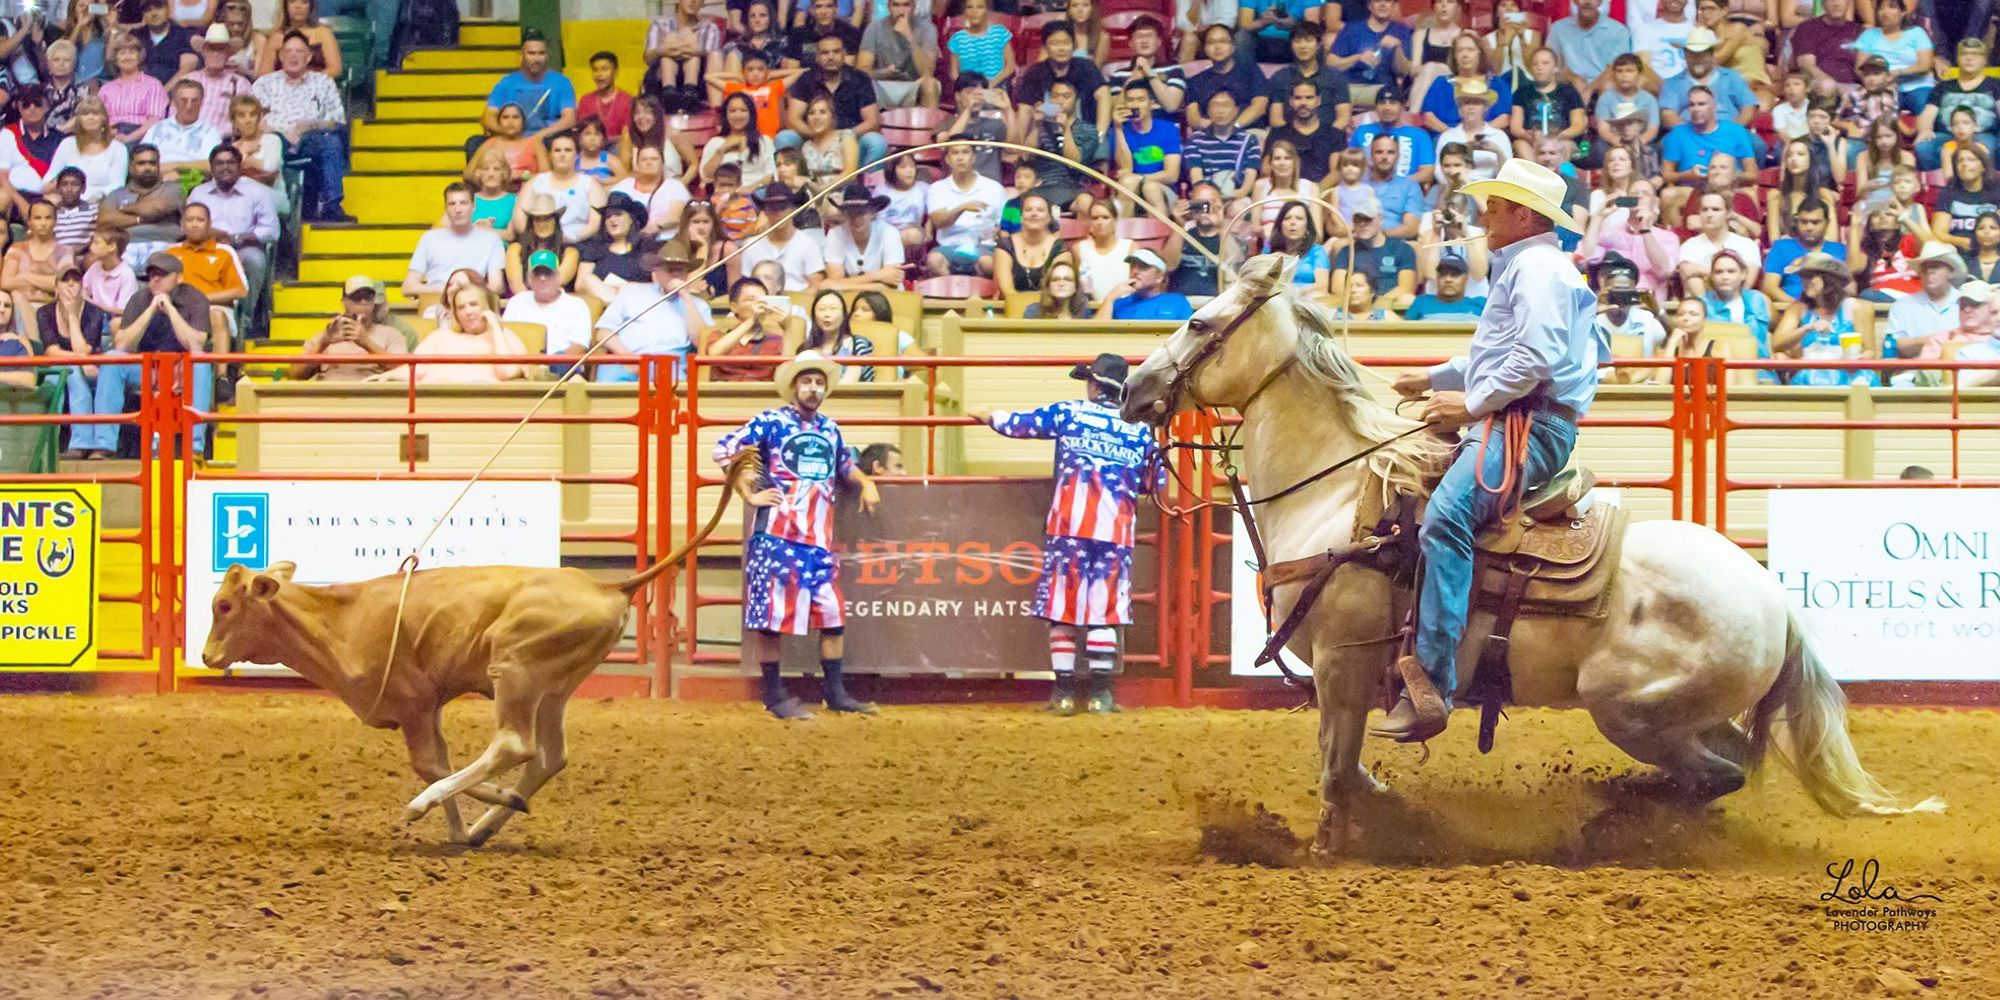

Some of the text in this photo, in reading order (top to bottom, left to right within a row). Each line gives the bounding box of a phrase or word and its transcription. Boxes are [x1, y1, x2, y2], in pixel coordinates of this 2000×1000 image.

[1060, 436, 1143, 465] STOCKYARDS
[1, 500, 76, 528] NTS
[287, 516, 529, 526] EMBASSY SUITES
[354, 547, 456, 557] HOTELS
[833, 541, 1043, 585] ETSO
[0, 582, 39, 596] OLD
[1777, 572, 1927, 609] HOTELS
[1936, 580, 1965, 609] &
[2, 600, 29, 614] KS
[974, 601, 1032, 616] HATS
[2, 626, 77, 640] PICKLE
[1882, 617, 1937, 638] fort
